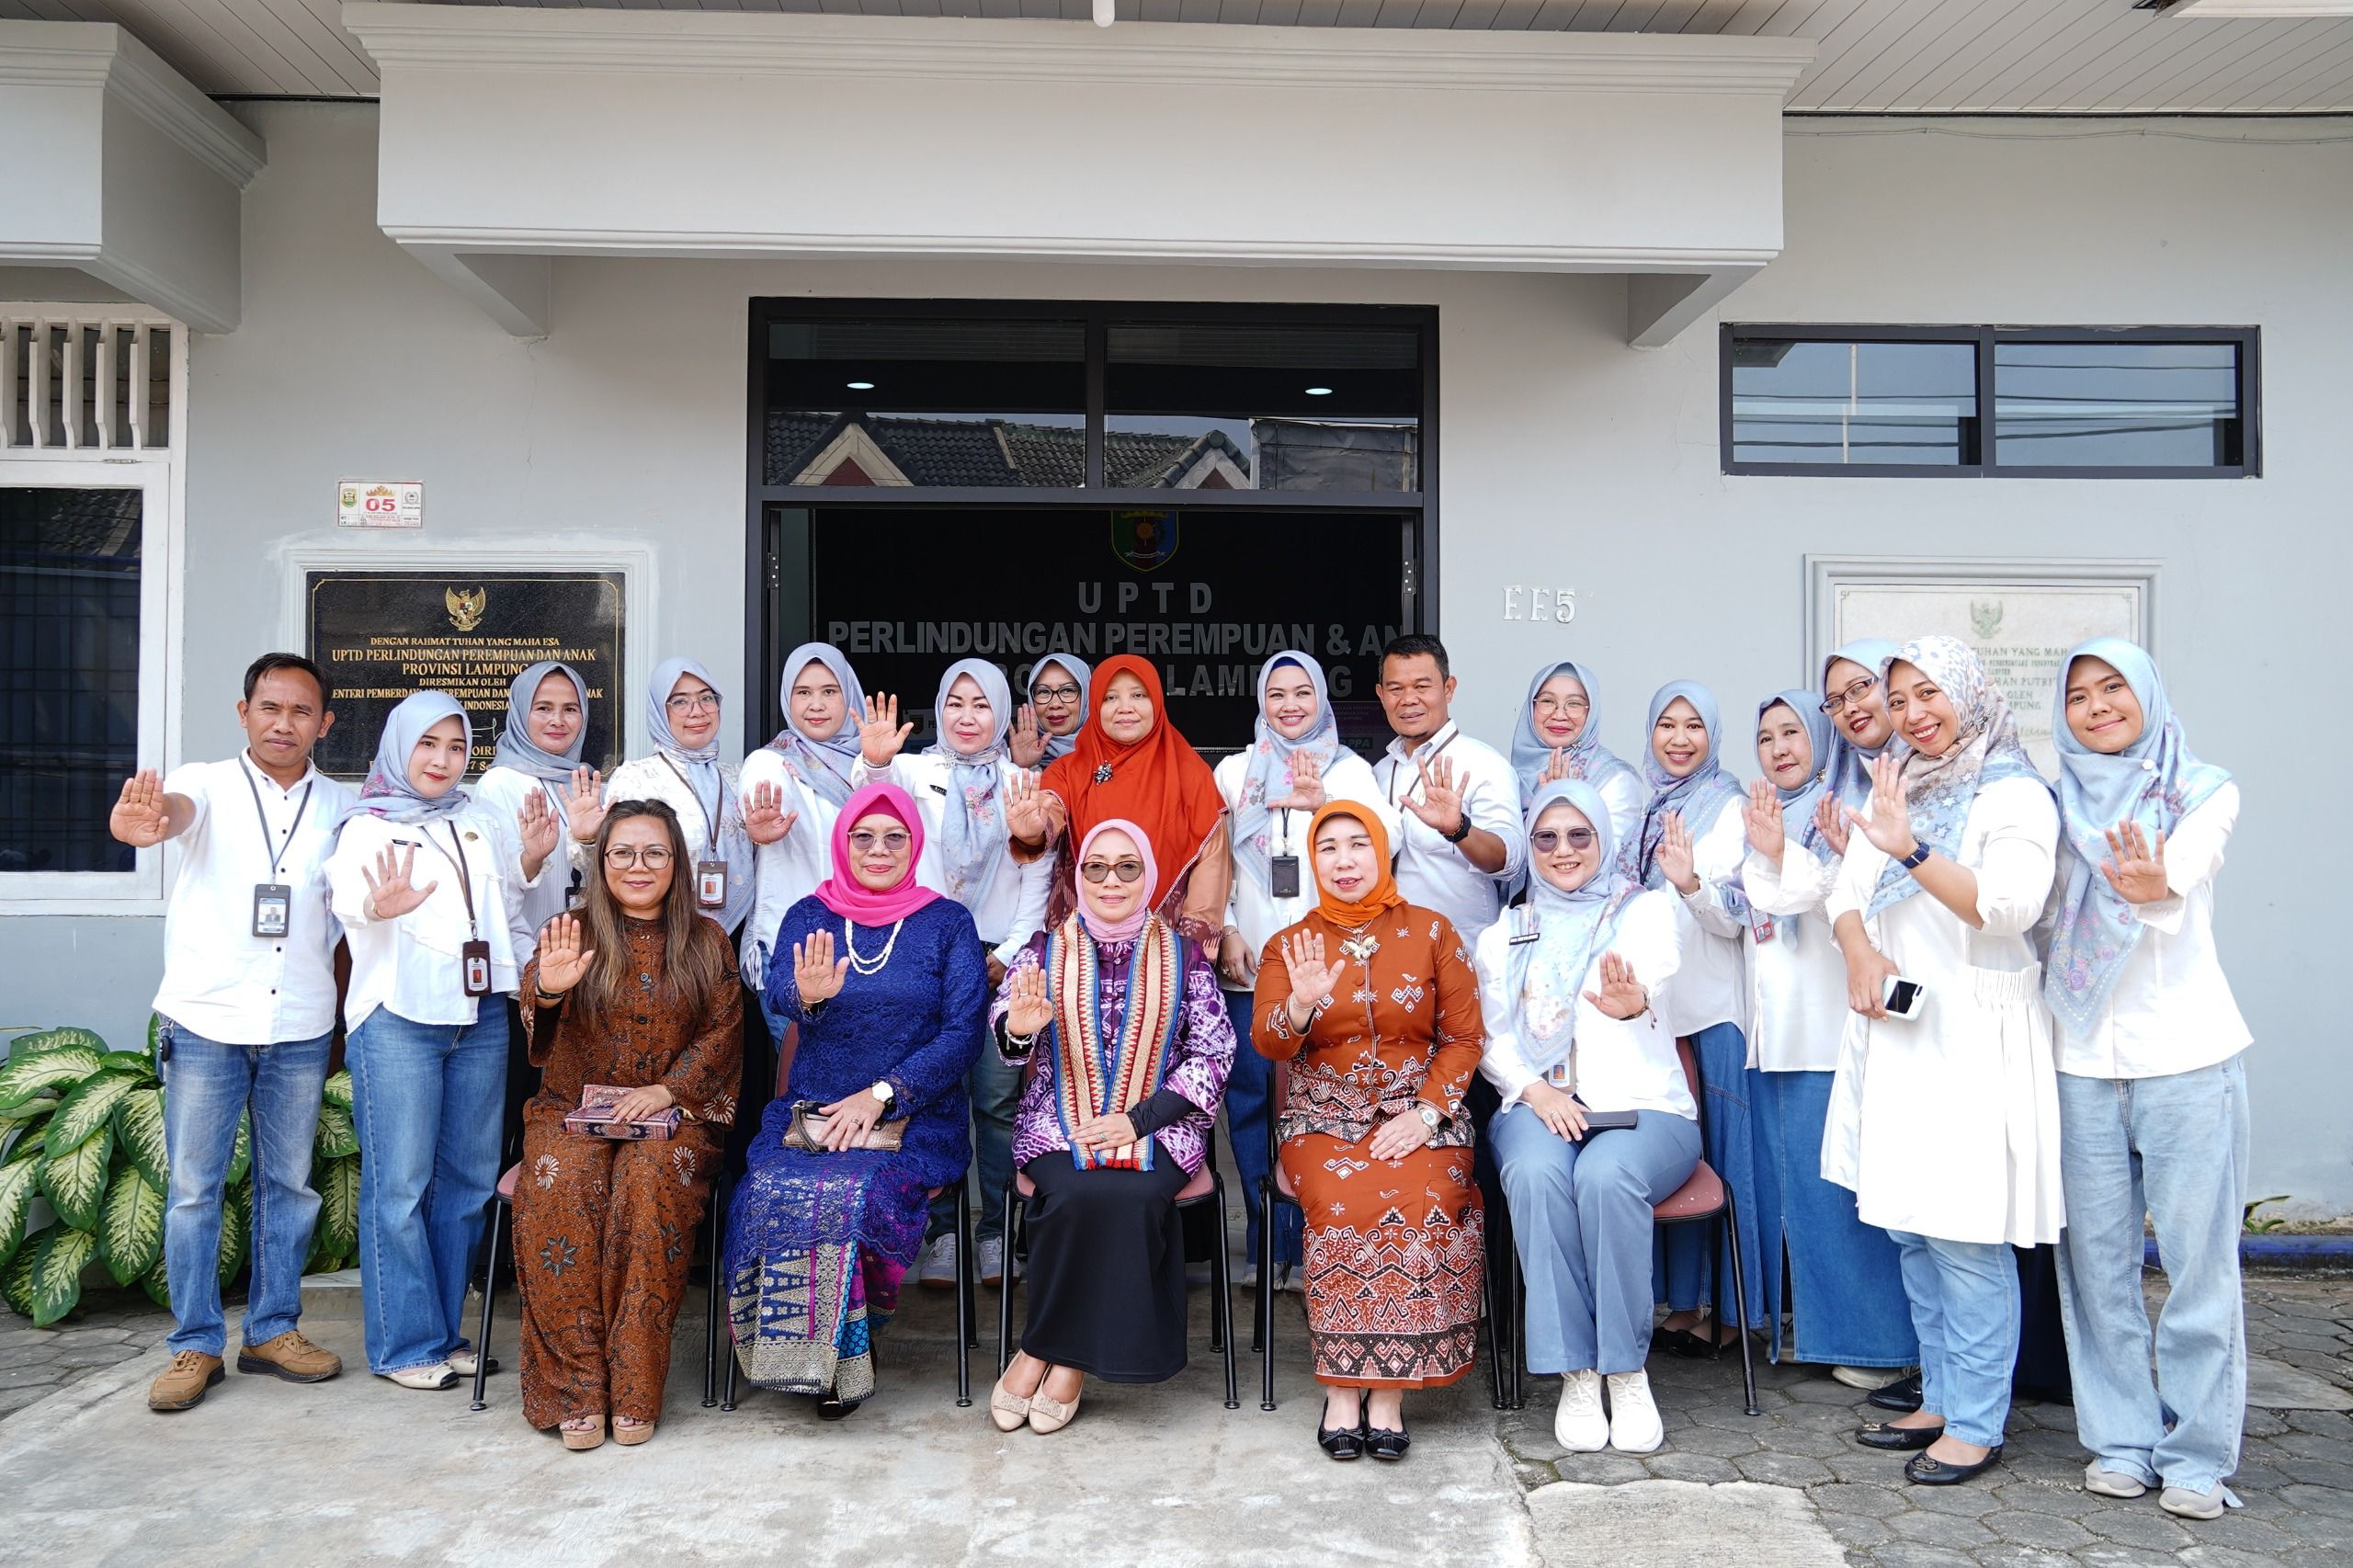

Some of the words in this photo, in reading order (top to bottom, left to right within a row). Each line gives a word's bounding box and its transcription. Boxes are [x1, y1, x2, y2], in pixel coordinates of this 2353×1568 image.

[366, 498, 396, 512] 05
[370, 637, 409, 645] DENGAN
[542, 638, 560, 646] ESA
[828, 621, 1097, 654] PERLINDUNGAN
[1105, 622, 1314, 655] PEREMPUAN
[1325, 623, 1351, 656] &
[1358, 625, 1403, 656] AN
[332, 649, 363, 661] UPTD
[366, 649, 460, 661] PERLINDUNGAN
[462, 649, 534, 661] PEREMPUAN
[536, 649, 561, 661] DAN
[563, 649, 597, 661] ANAK
[2011, 648, 2040, 656] YANG
[2044, 648, 2068, 656] MAH
[402, 663, 461, 675] PROVINSI
[419, 677, 478, 687] DIRESMIKAN
[480, 677, 506, 687] OLEH
[1166, 664, 1352, 698] LAMPG
[332, 688, 365, 699] ENTERI
[367, 688, 437, 699] PEMBERDAY
[440, 688, 491, 699] EREMPUAN
[587, 688, 604, 699] NAK
[463, 700, 510, 710] INDONESIA
